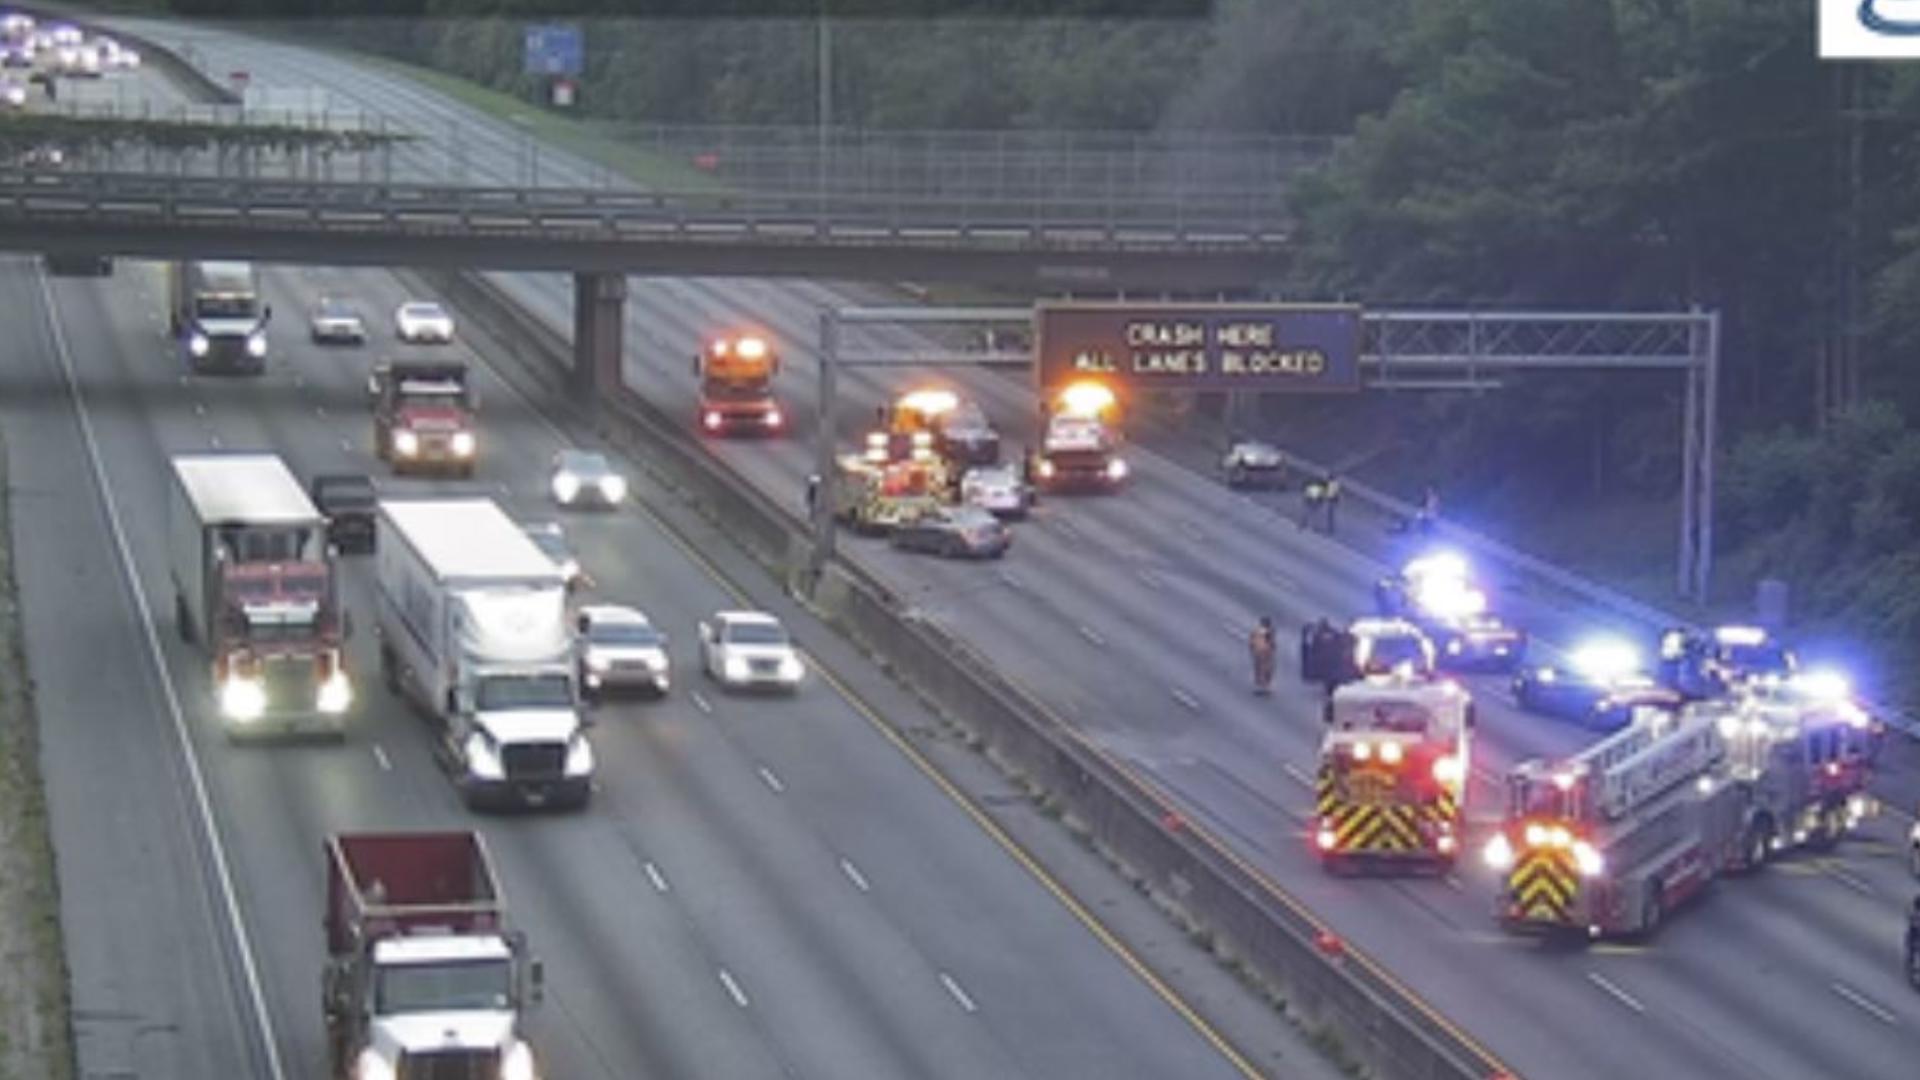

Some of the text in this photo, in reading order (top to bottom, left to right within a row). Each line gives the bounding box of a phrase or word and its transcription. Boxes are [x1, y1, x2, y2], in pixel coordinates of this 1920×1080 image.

[1128, 323, 1273, 345] CRASH HERE
[1075, 352, 1324, 373] ALL LANES BLOCKED
